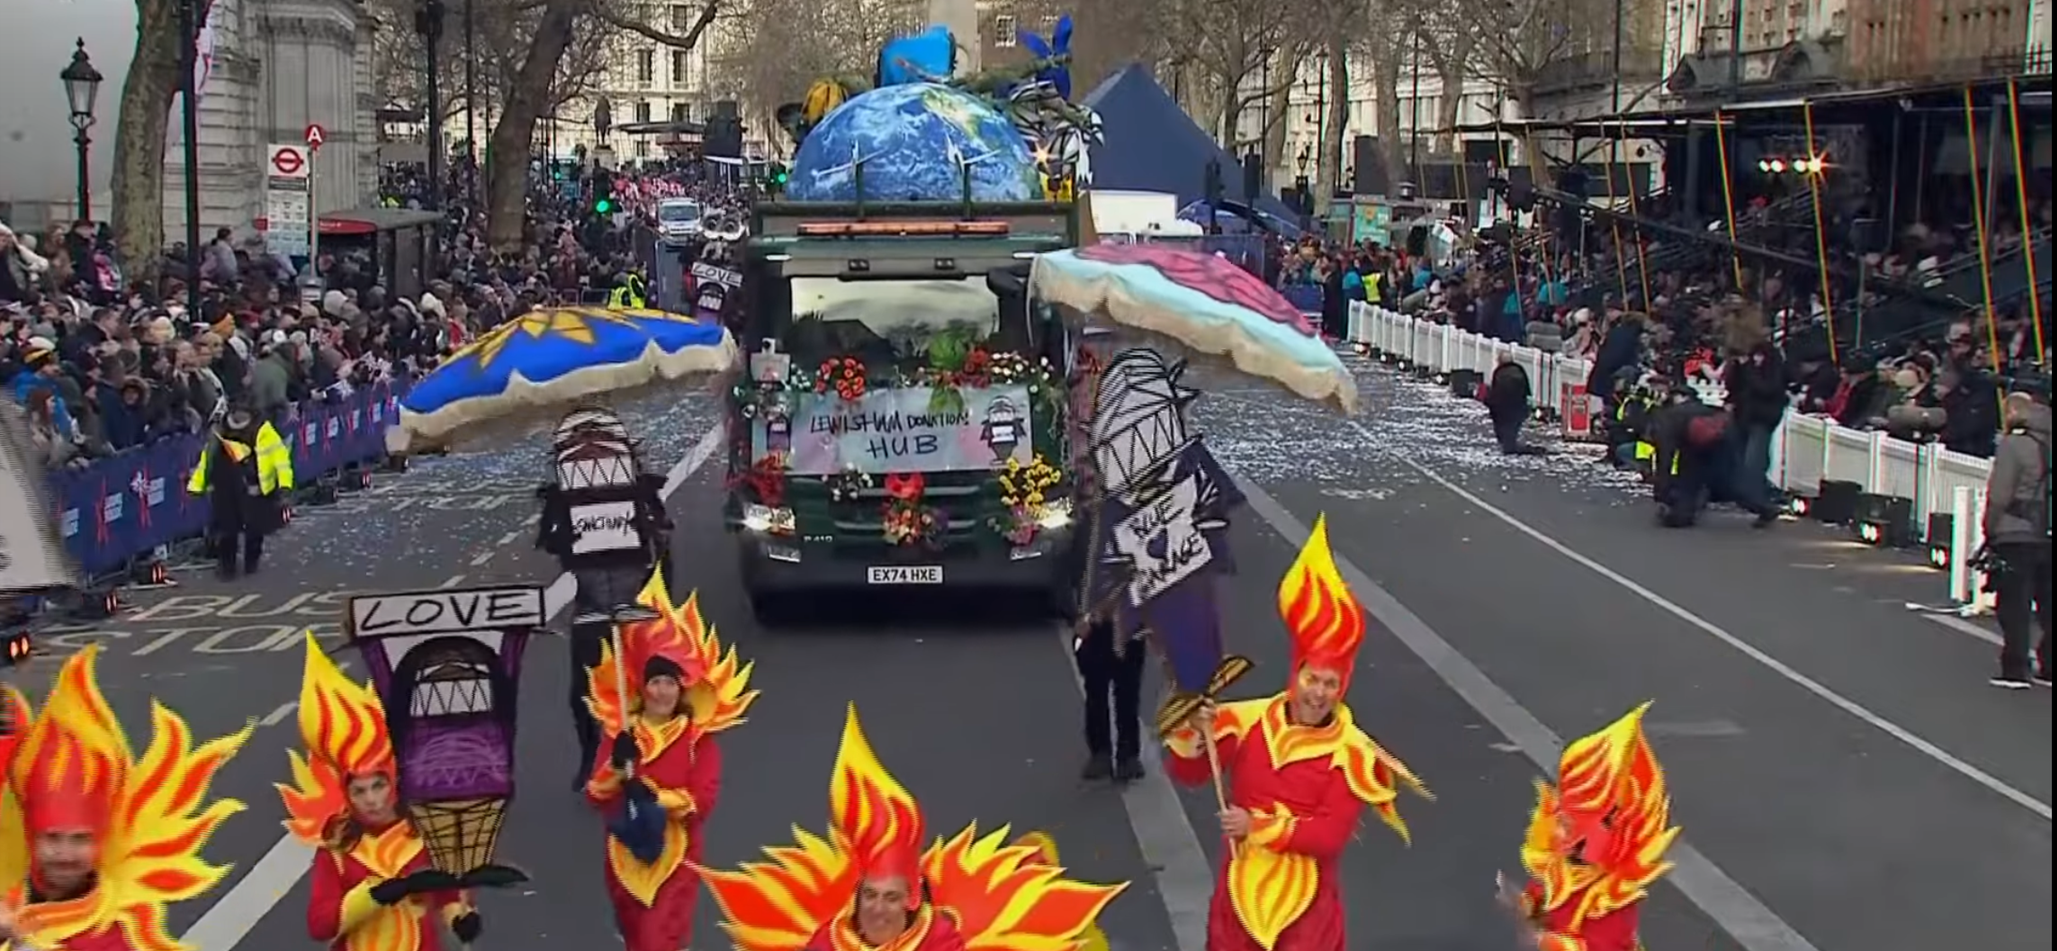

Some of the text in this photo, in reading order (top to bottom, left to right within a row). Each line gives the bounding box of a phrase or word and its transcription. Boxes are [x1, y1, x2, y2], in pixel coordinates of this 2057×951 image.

[307, 126, 322, 142] A
[693, 264, 740, 285] LOVE
[810, 410, 903, 434] LEWISHAM
[865, 434, 938, 459] HUB
[1128, 494, 1185, 540] BLUE
[873, 569, 937, 582] EX74 HXE
[128, 590, 354, 621] BUS
[360, 593, 540, 631] LOVE
